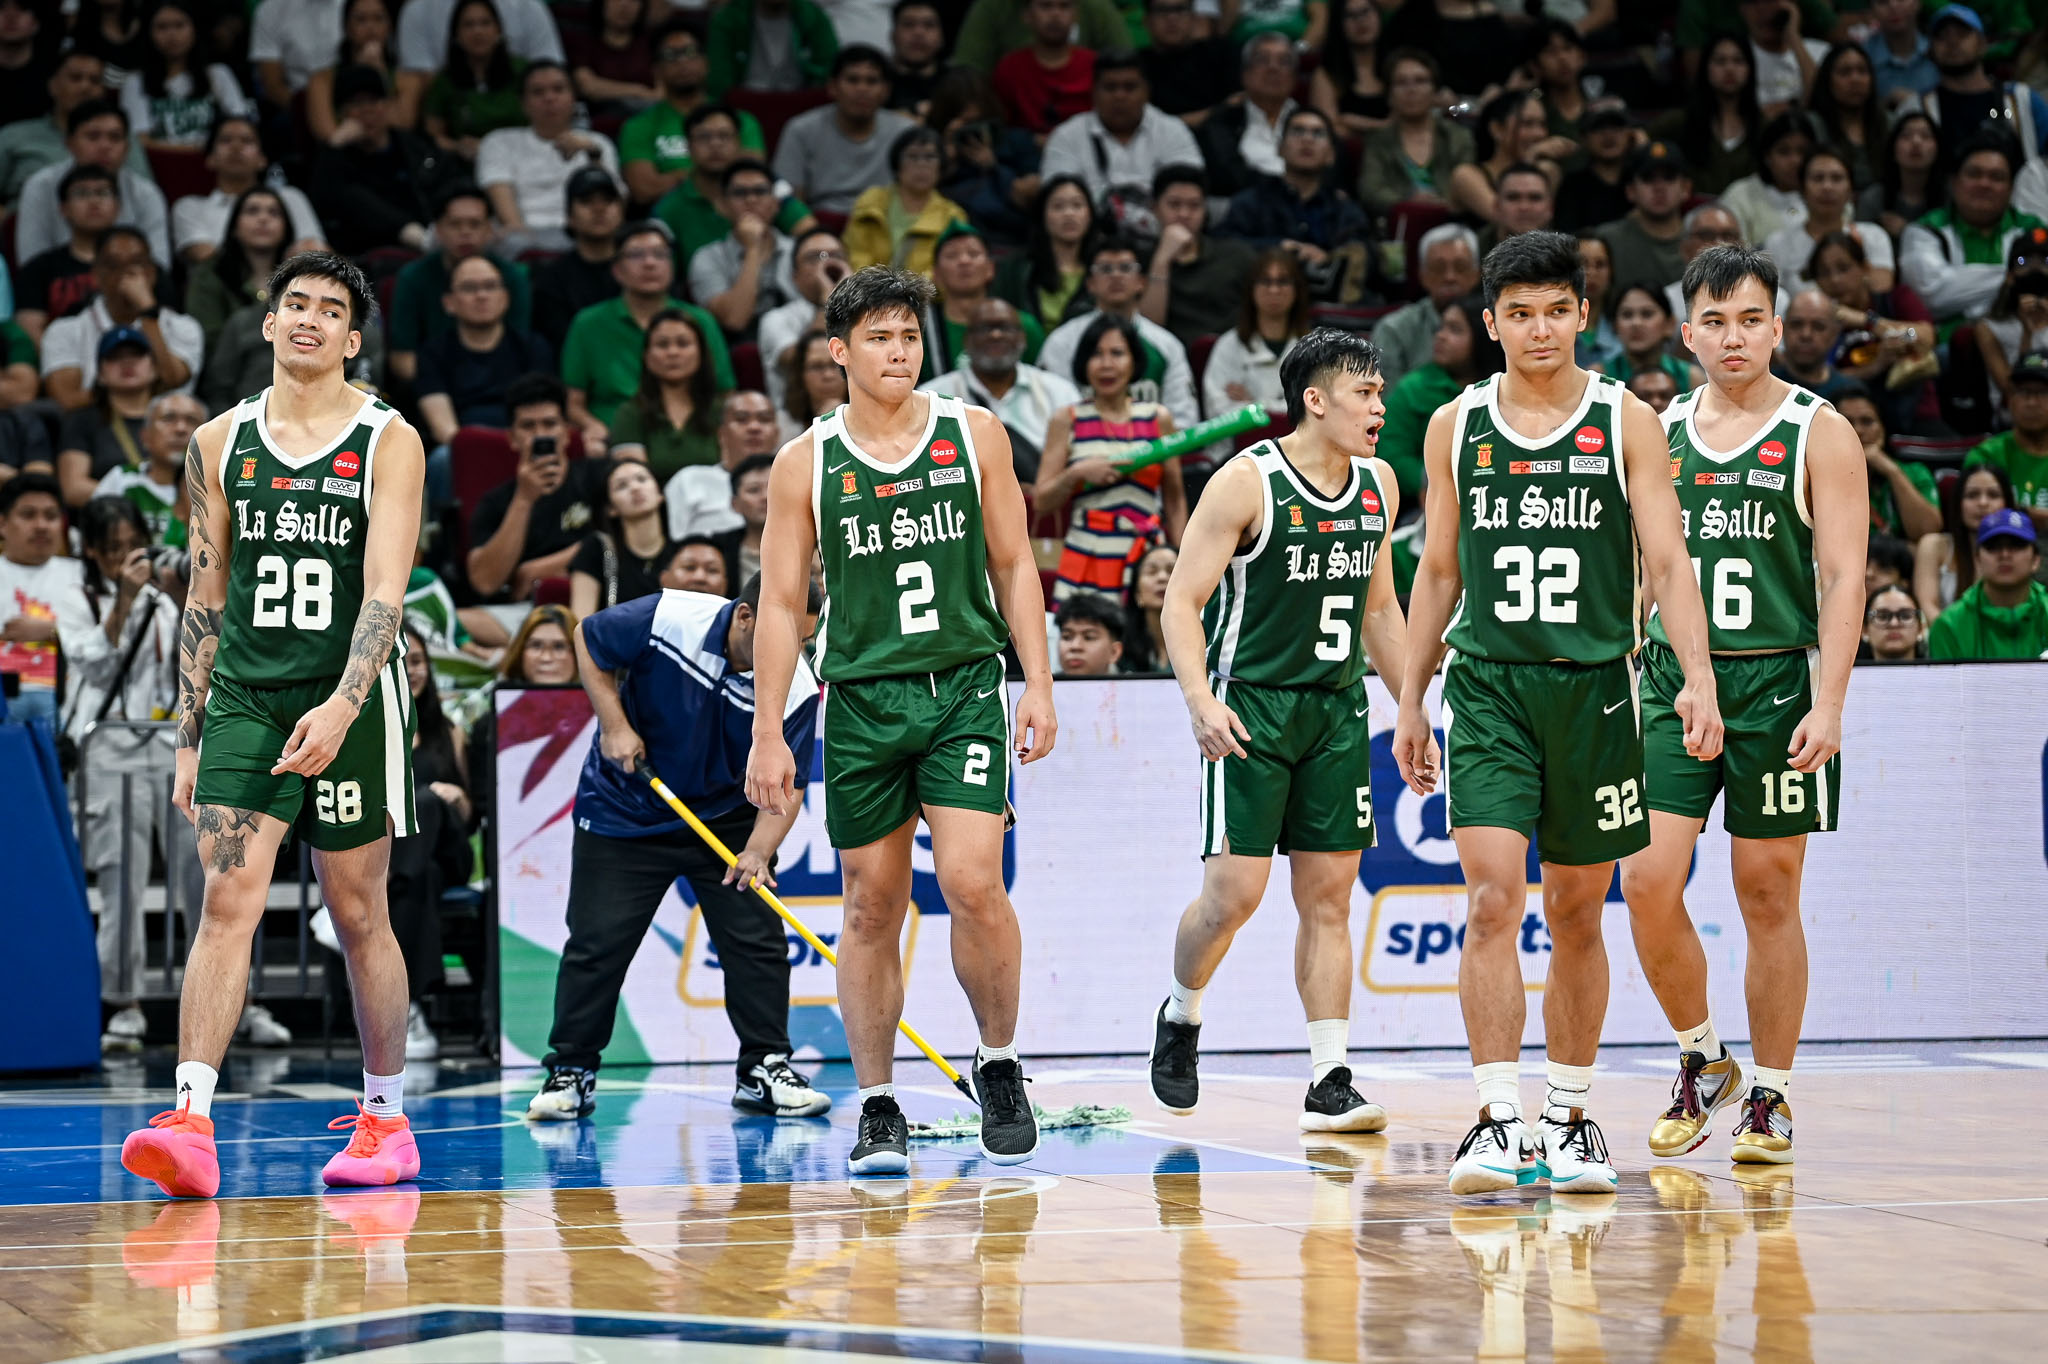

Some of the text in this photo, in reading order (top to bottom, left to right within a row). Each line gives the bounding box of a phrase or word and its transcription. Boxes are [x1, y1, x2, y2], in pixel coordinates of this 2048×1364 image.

[931, 449, 955, 457] Gazz
[1577, 434, 1602, 445] Gazz
[1760, 448, 1784, 458] Gazz
[291, 479, 315, 489] ICTSI
[334, 459, 358, 470] Gazz
[935, 470, 960, 479] CWC
[1531, 462, 1560, 471] ICTSI
[1577, 459, 1602, 467] CWC
[1715, 474, 1739, 483] ICTSI
[1755, 473, 1779, 483] CWC
[330, 481, 354, 491] CWC
[895, 479, 922, 493] ICTSI
[235, 499, 352, 547] La Salle
[1334, 520, 1356, 529] ICTSI
[1469, 484, 1603, 531] La Salle
[1681, 497, 1776, 541] a Salle
[840, 500, 965, 559] La Salle
[1285, 540, 1377, 582] La Sall
[253, 555, 333, 631] 28
[895, 560, 940, 635] 2
[1493, 545, 1580, 623] 32
[1314, 595, 1354, 662] 5
[963, 743, 990, 786] 2
[316, 779, 362, 824] 28
[1356, 785, 1371, 828] 5
[1595, 777, 1643, 832] 32
[1761, 770, 1805, 816] 16
